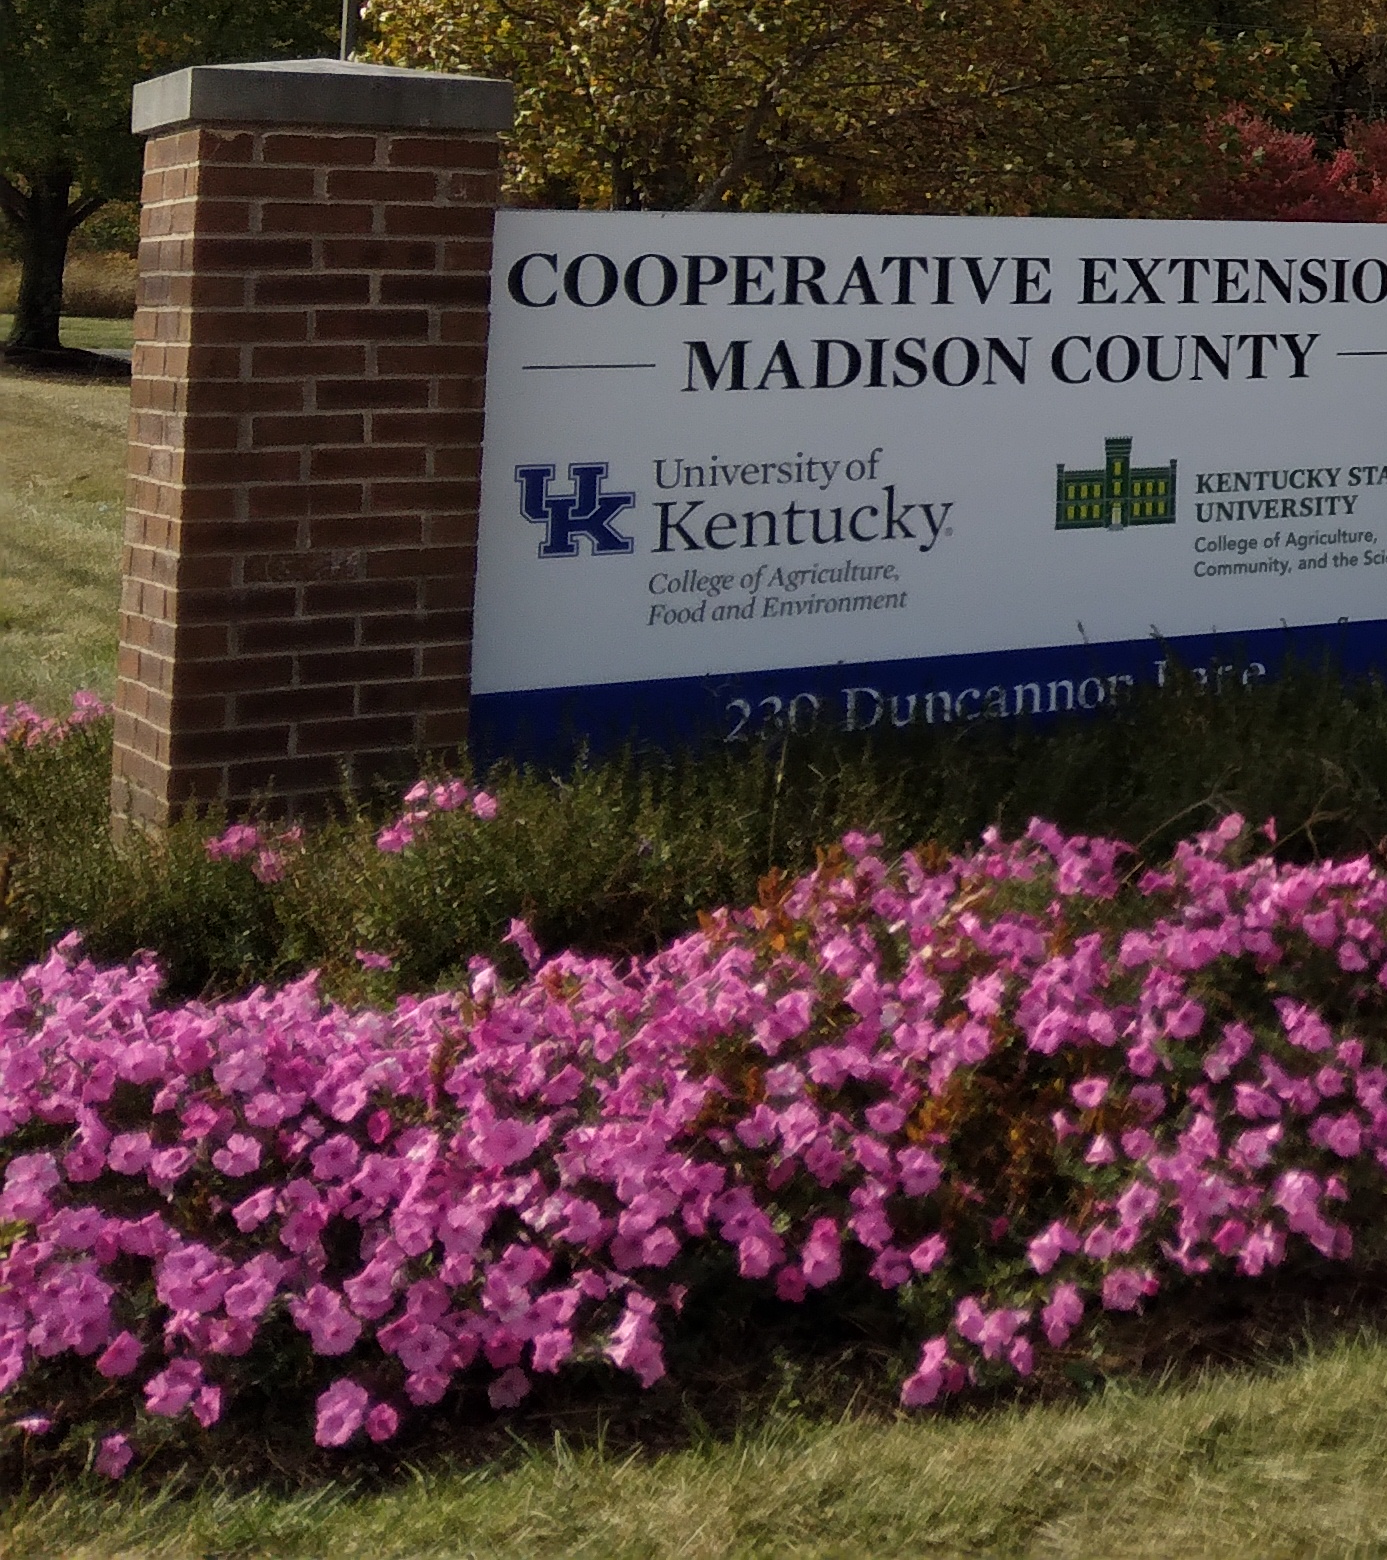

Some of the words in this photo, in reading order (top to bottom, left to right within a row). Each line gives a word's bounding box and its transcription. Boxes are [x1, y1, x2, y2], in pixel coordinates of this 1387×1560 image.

[507, 252, 1053, 308] COOPERATIVE
[680, 336, 1034, 392] MADISON
[1050, 332, 1322, 385] COUNTY
[652, 451, 841, 491] University
[845, 447, 884, 482] of
[1195, 467, 1342, 495] KENTUCKY
[514, 461, 636, 559] UK
[650, 484, 955, 554] Kentucky
[1195, 494, 1359, 523] UNIVERSITY
[1194, 535, 1259, 555] College
[1263, 531, 1281, 549] of
[1285, 528, 1378, 552] Agriculture,
[647, 568, 734, 597] College
[739, 565, 768, 594] of
[767, 560, 901, 592] Agriculture,
[1194, 556, 1293, 578] Community,
[1298, 552, 1328, 571] and
[1332, 552, 1359, 569] the
[647, 601, 705, 627] Food
[711, 598, 756, 622] and
[762, 590, 908, 619] Environment
[723, 691, 821, 743] 230
